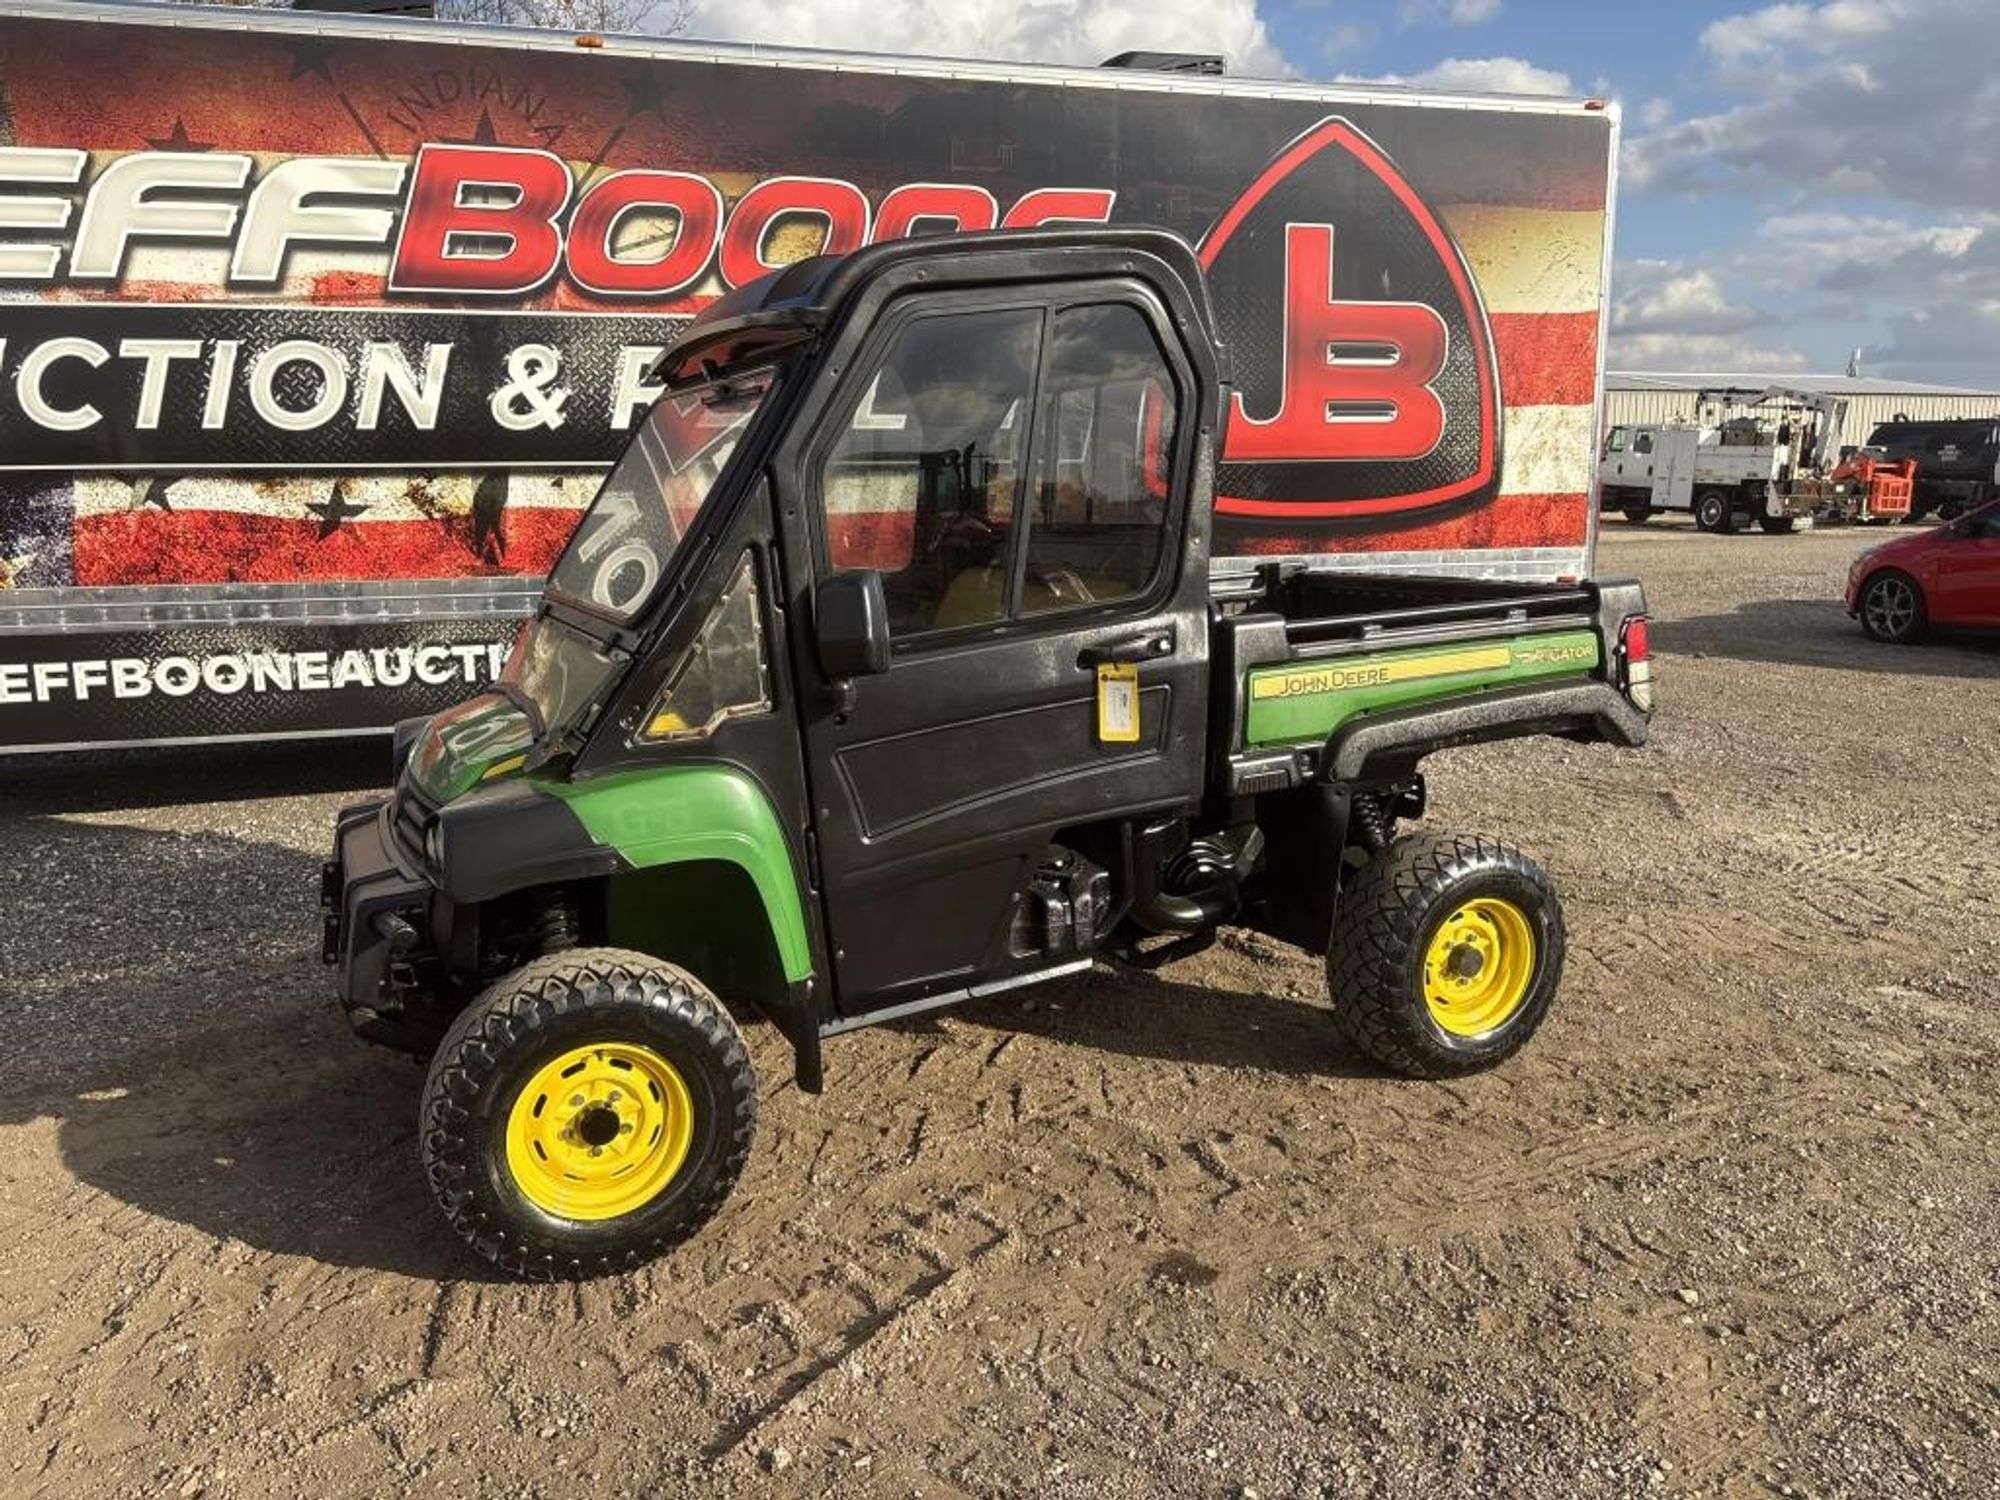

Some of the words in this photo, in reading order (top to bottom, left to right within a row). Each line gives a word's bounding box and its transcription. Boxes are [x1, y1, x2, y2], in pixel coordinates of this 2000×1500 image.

[386, 66, 563, 150] INDIANA
[0, 336, 454, 431] CTION
[490, 343, 568, 431] &
[1218, 222, 1449, 462] JB
[1279, 674, 1328, 695] JOHN
[1331, 668, 1389, 688] DEERE
